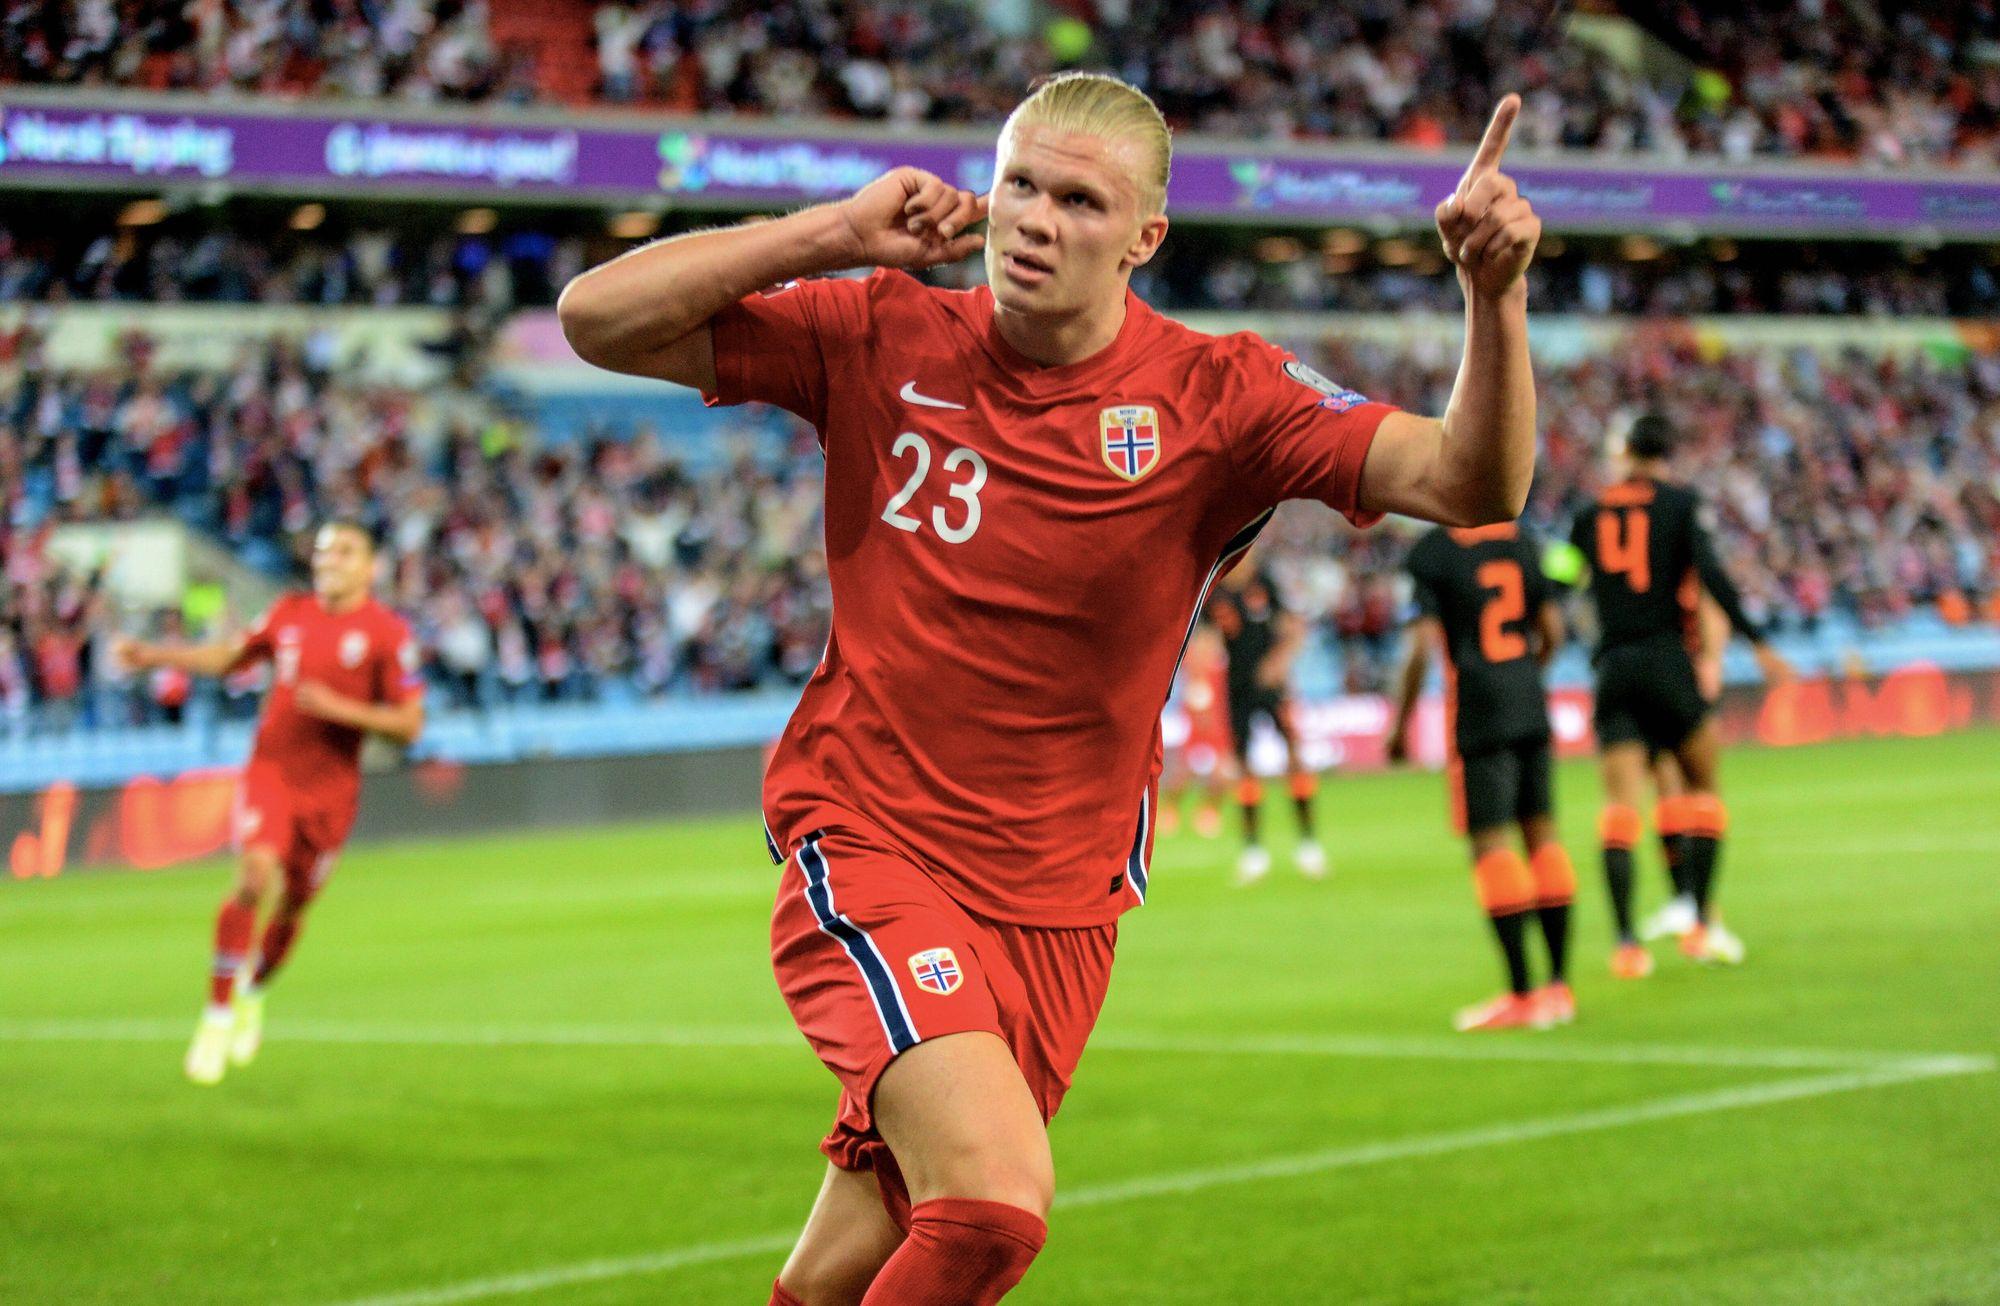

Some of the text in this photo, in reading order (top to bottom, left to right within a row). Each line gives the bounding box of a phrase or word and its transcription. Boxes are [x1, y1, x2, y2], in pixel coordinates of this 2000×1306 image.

[881, 432, 988, 544] 23
[1596, 508, 1650, 593] 4
[1475, 559, 1527, 663] 2
